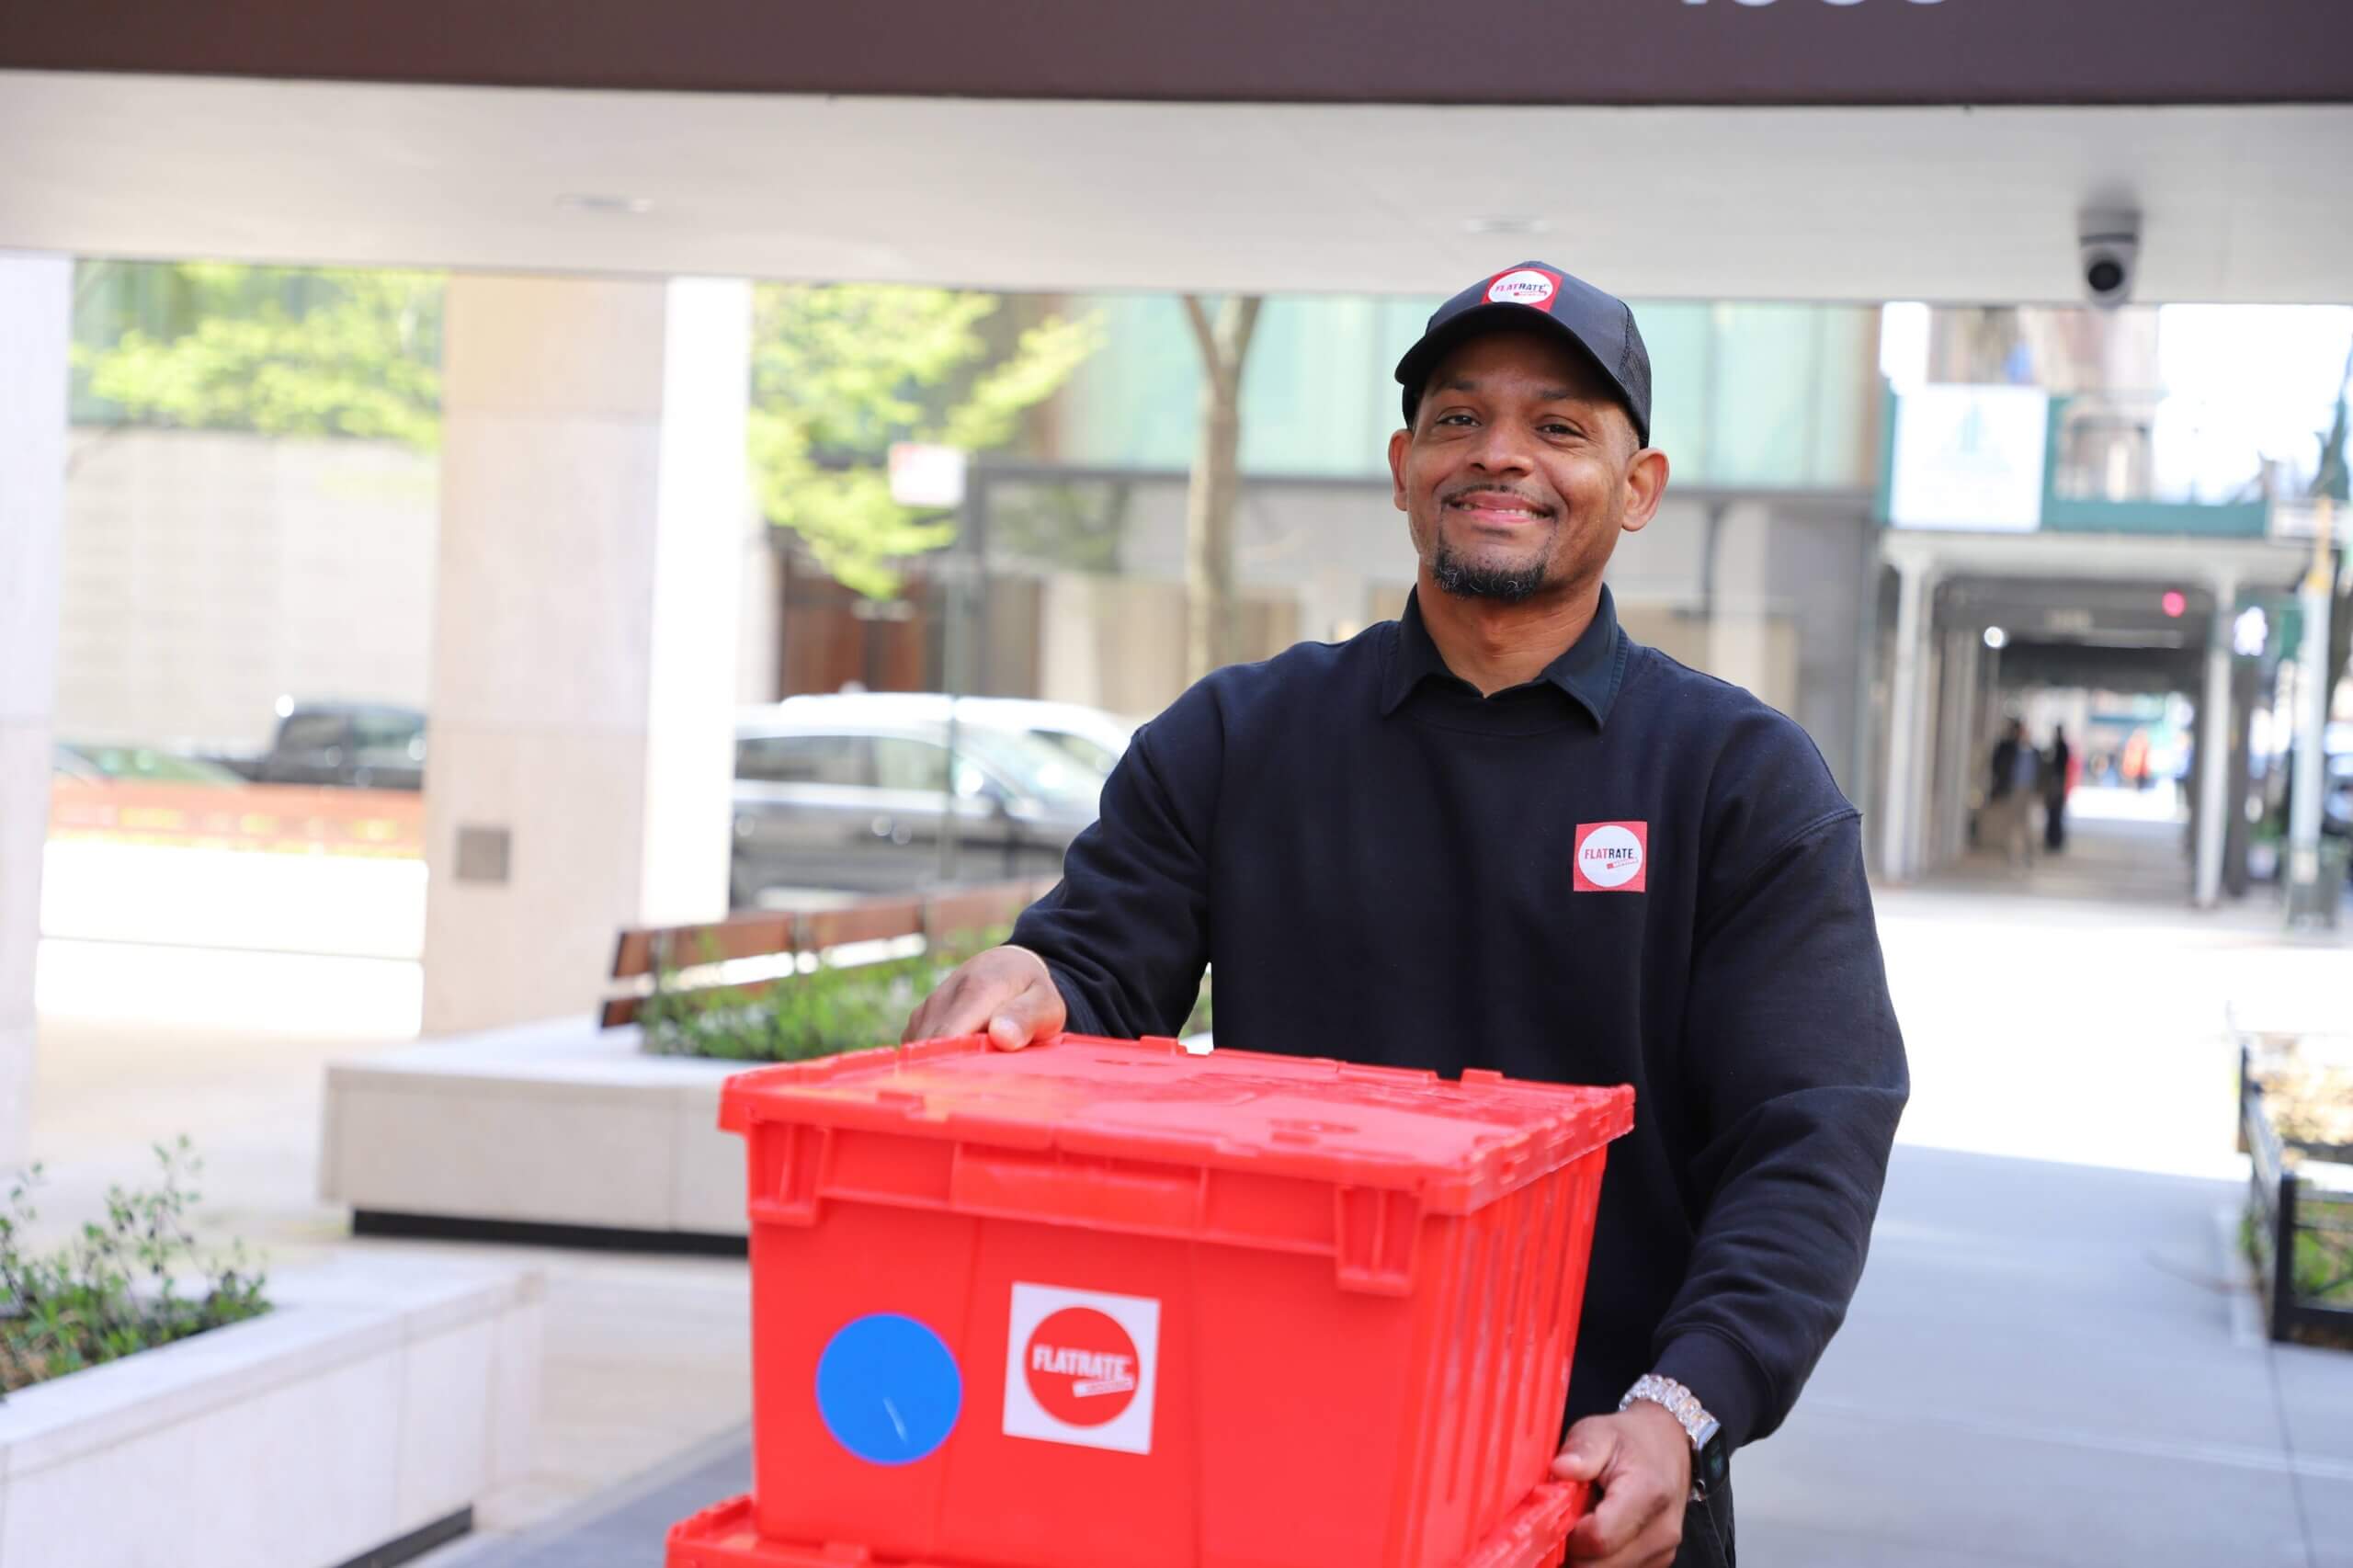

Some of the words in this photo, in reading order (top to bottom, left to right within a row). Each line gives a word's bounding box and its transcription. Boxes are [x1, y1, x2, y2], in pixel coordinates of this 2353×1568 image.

[1495, 283, 1547, 293] FLATRATE
[1585, 847, 1633, 859] FLATRATE
[1031, 1345, 1129, 1382] FLATRATE
